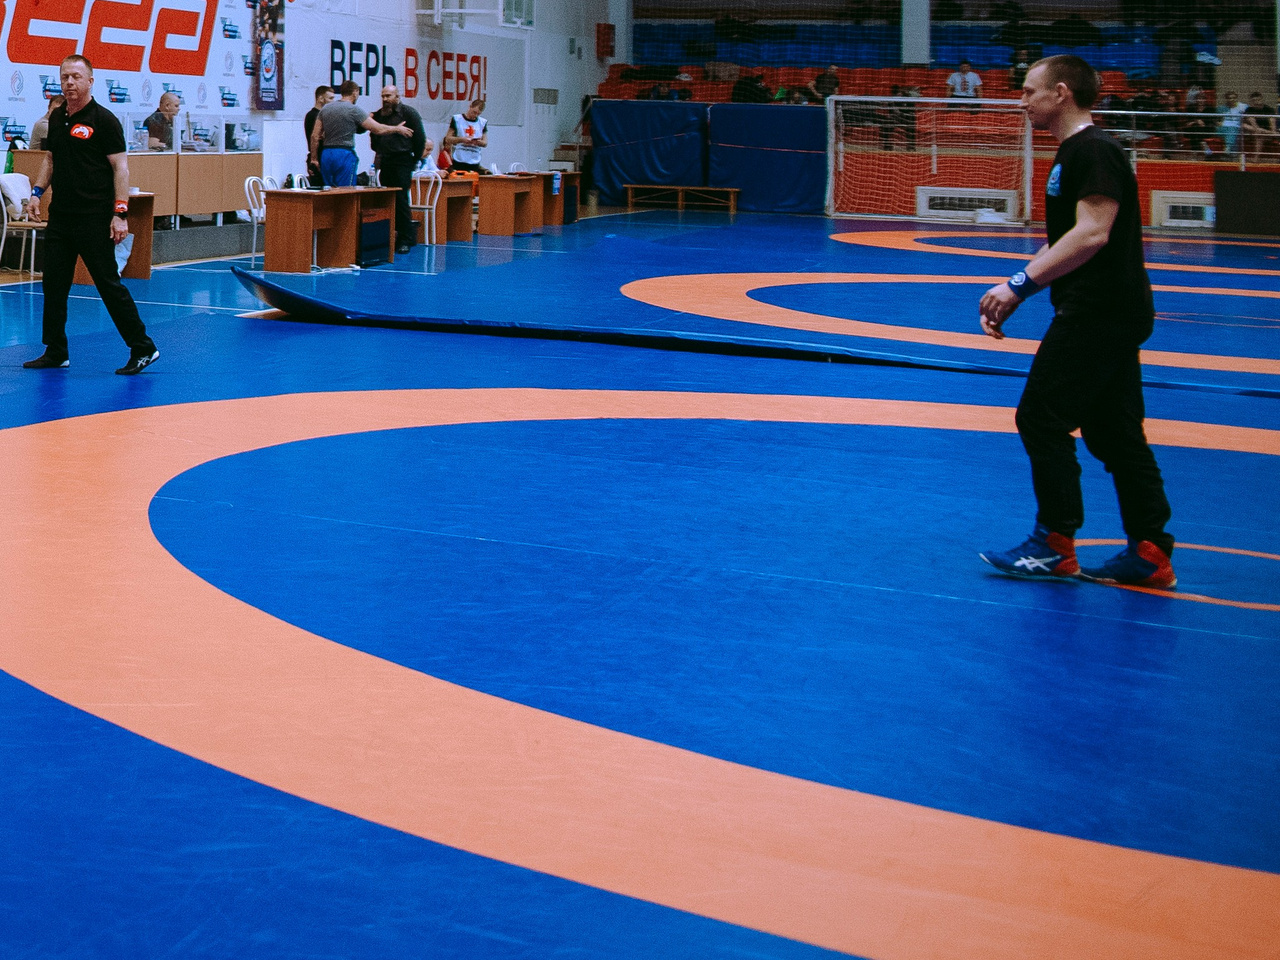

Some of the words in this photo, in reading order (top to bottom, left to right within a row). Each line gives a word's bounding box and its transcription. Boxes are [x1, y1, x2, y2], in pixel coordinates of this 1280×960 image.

[331, 39, 396, 96] ВЕРЬ
[404, 47, 419, 99] В
[427, 50, 487, 102] СЕБЯ!
